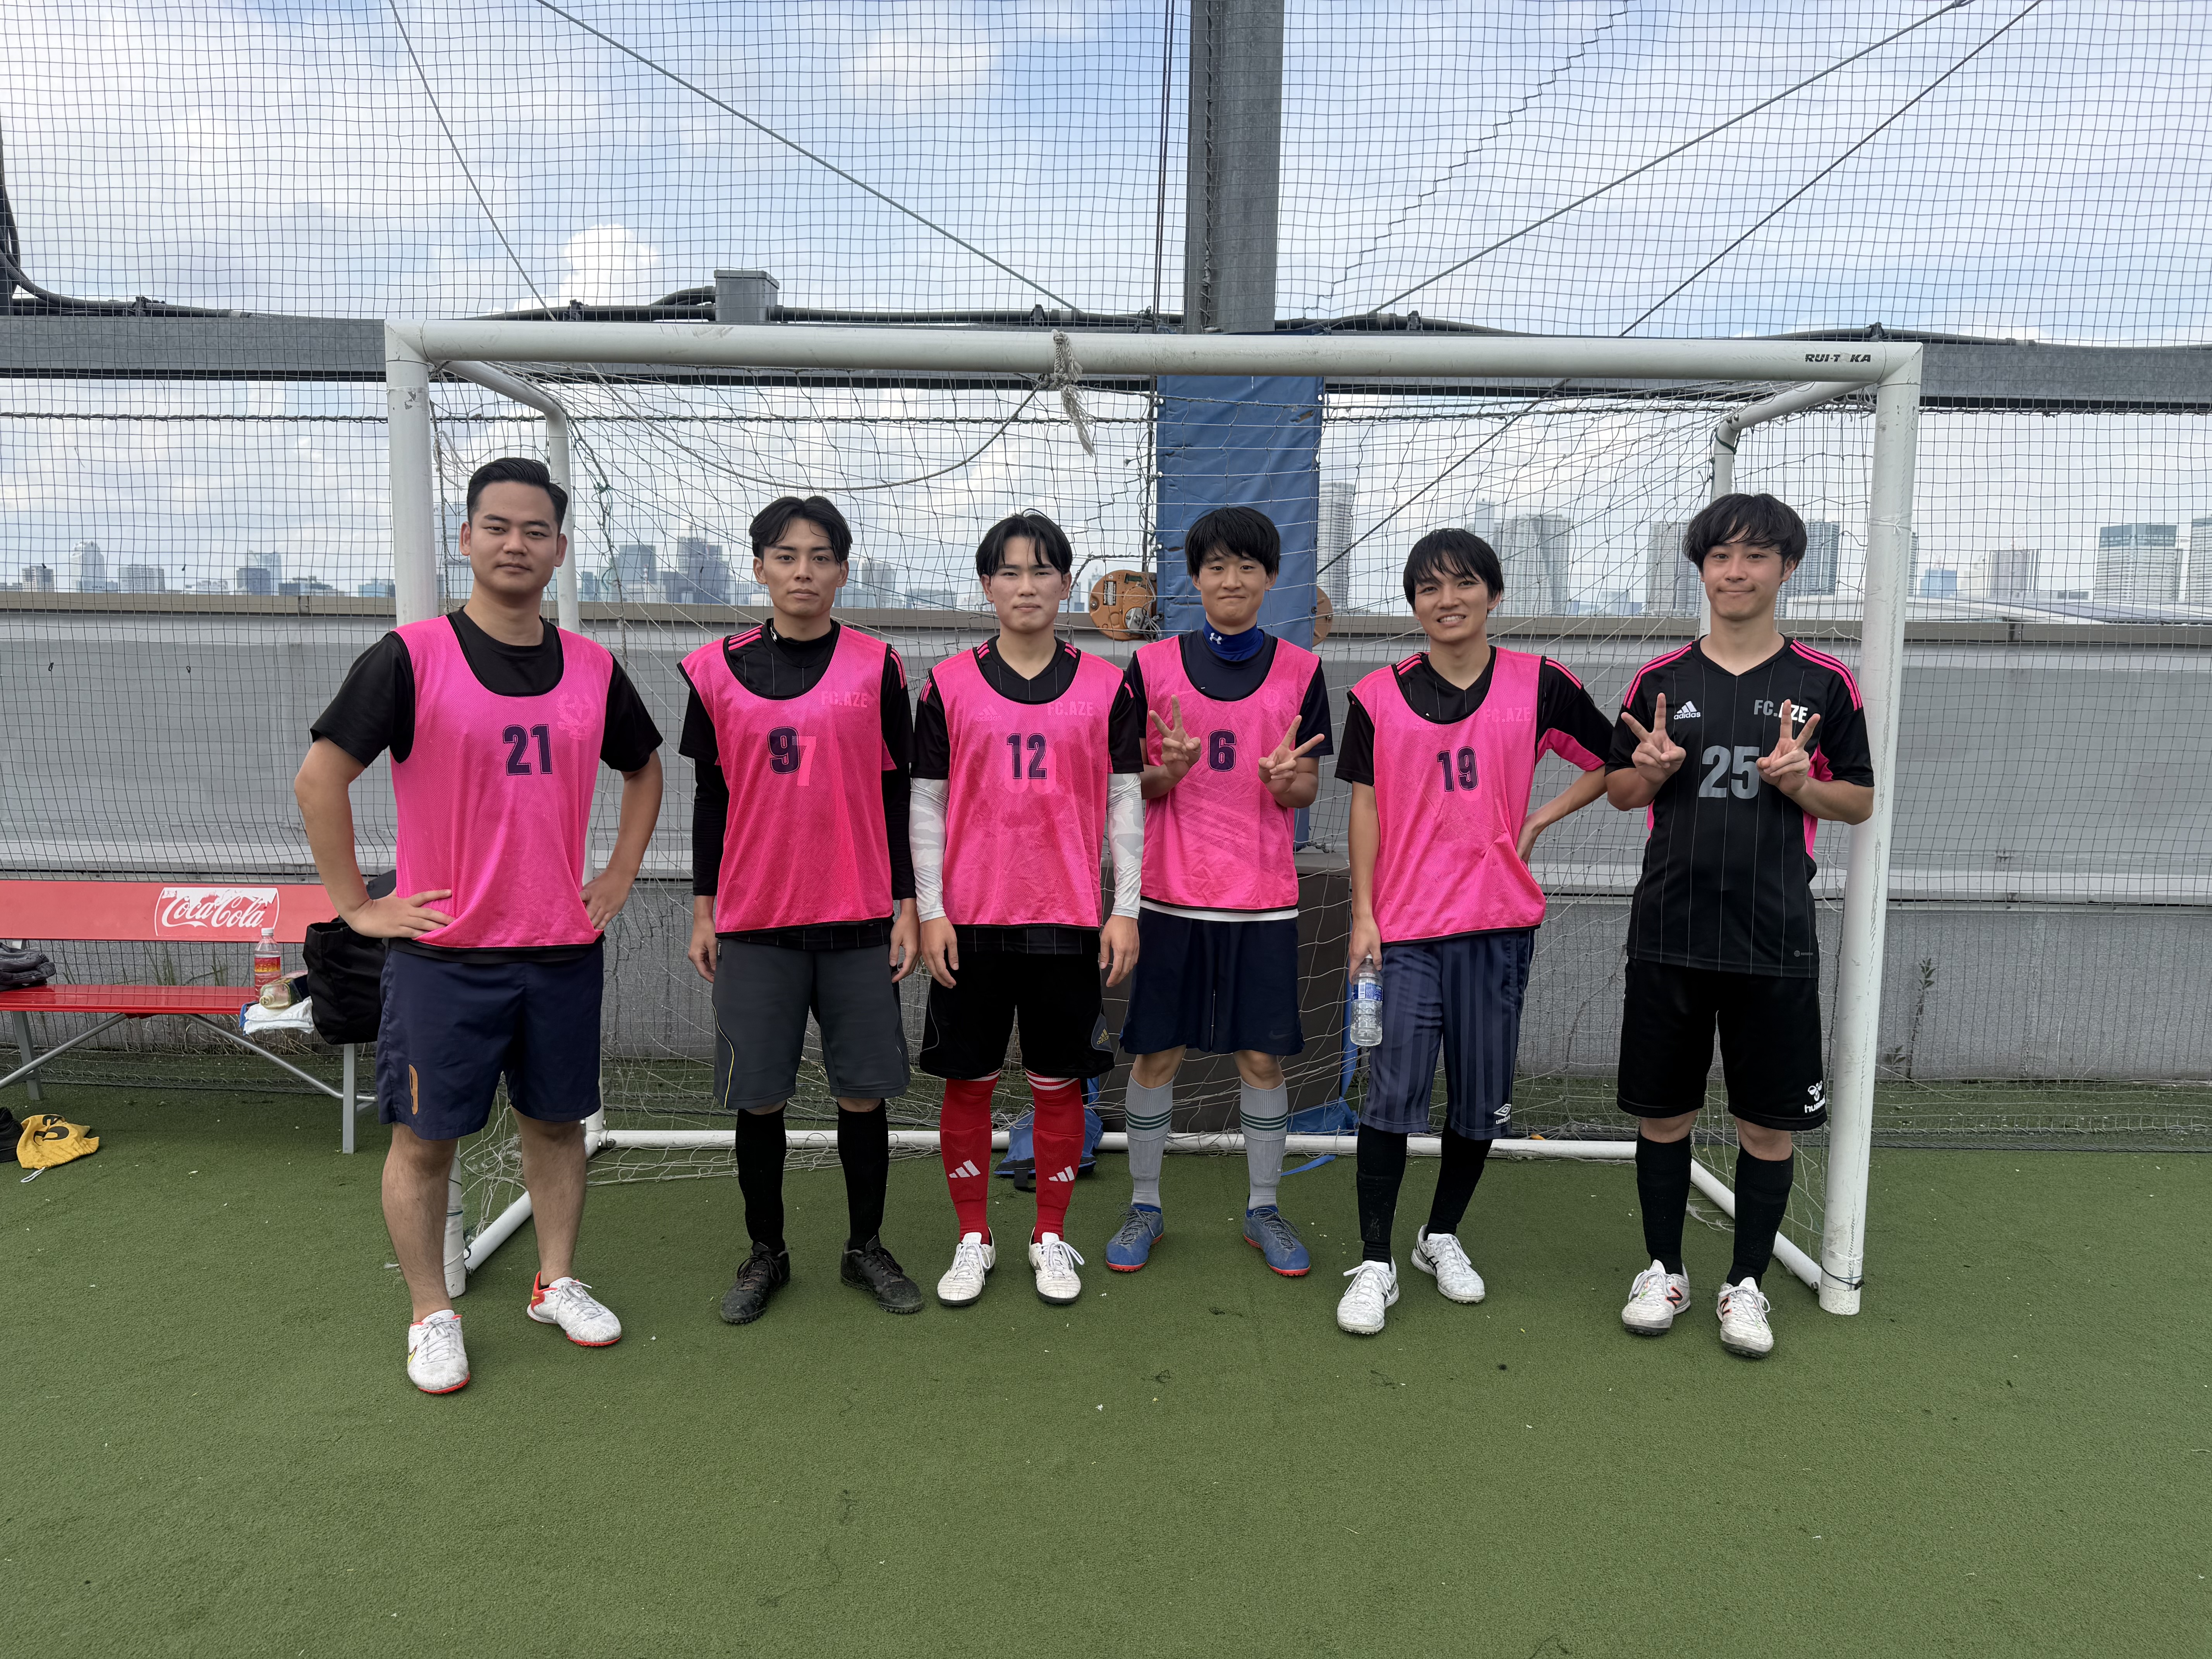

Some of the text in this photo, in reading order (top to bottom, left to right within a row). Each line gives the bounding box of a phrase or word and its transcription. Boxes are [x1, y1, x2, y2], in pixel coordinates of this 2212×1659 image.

[1805, 354, 1871, 362] RUI-TKA
[503, 724, 553, 776] 21
[767, 726, 800, 774] 9
[1006, 733, 1047, 780] 12
[1207, 729, 1237, 772] 6
[1436, 746, 1479, 792] 19
[1698, 745, 1760, 799] 25
